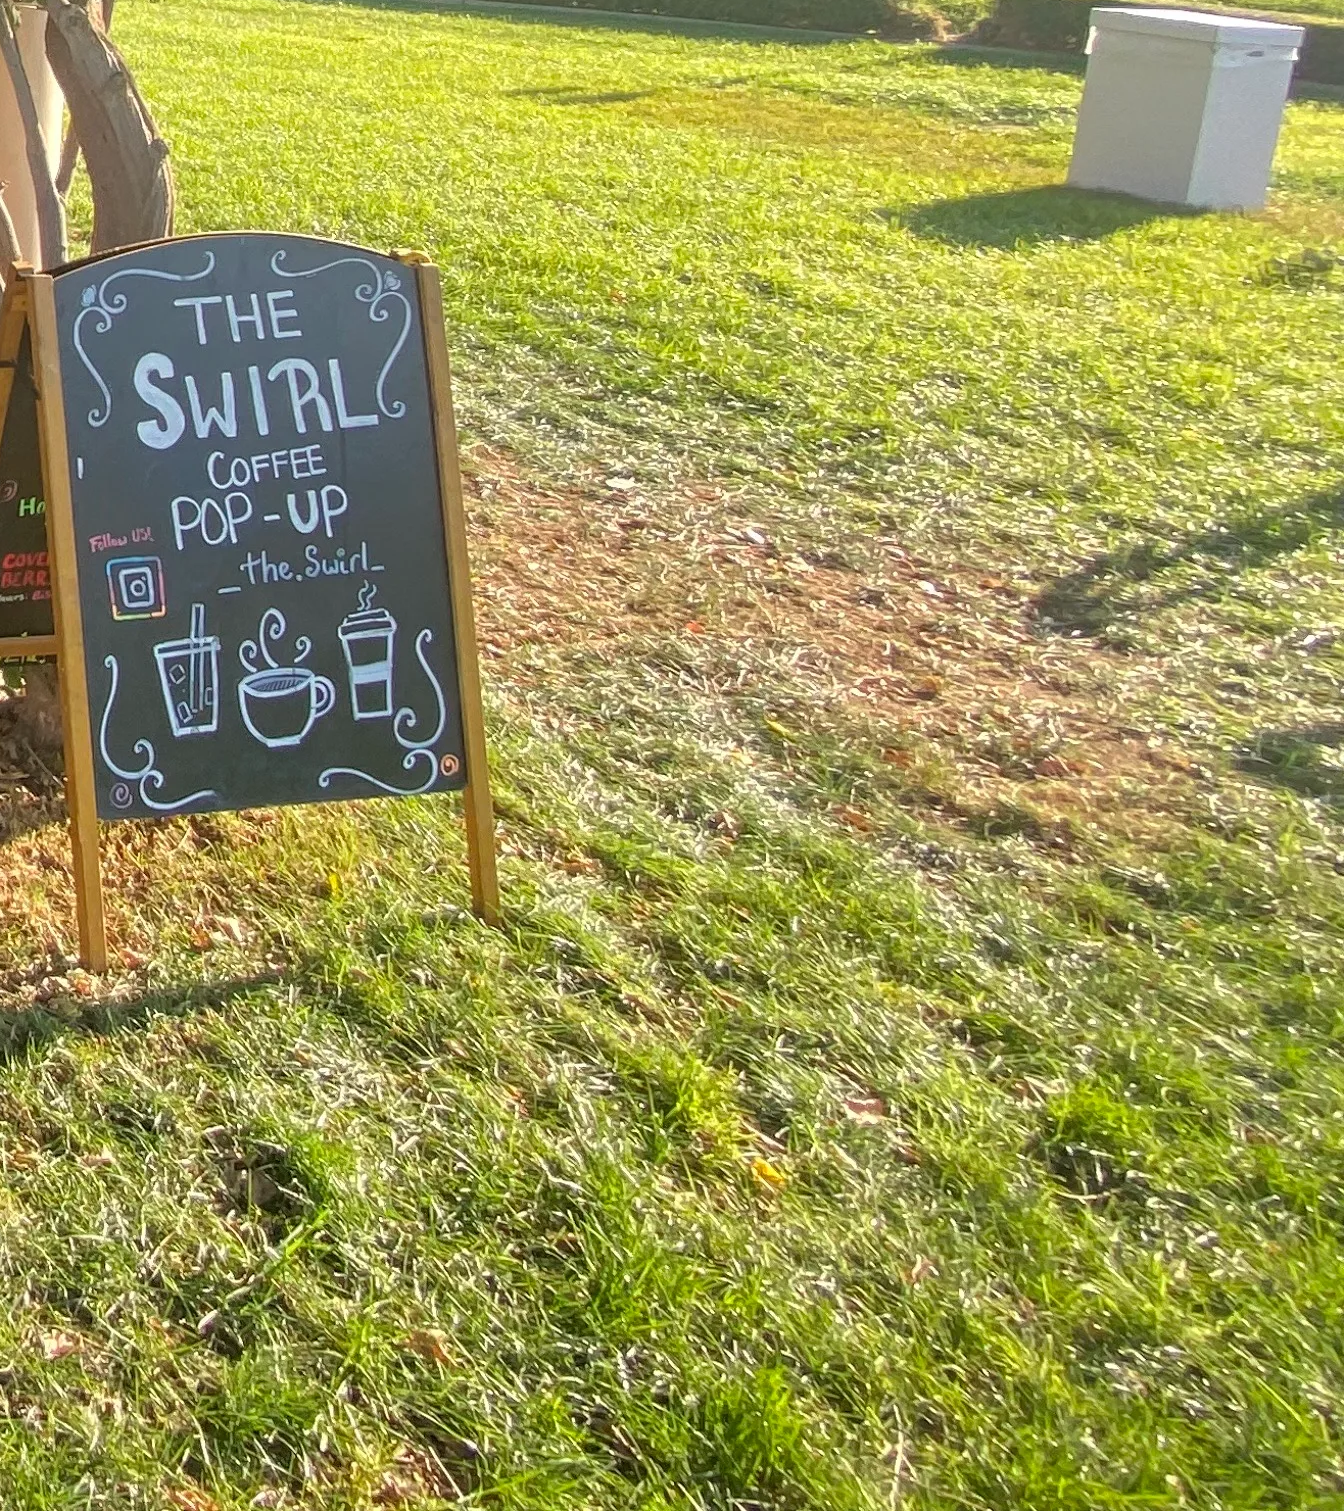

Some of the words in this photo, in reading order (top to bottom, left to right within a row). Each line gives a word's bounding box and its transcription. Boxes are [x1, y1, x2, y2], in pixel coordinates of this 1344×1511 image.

[174, 289, 303, 346] THE
[134, 352, 380, 450] SWIRL
[206, 443, 327, 490] COFFEE
[88, 532, 128, 554] Follow
